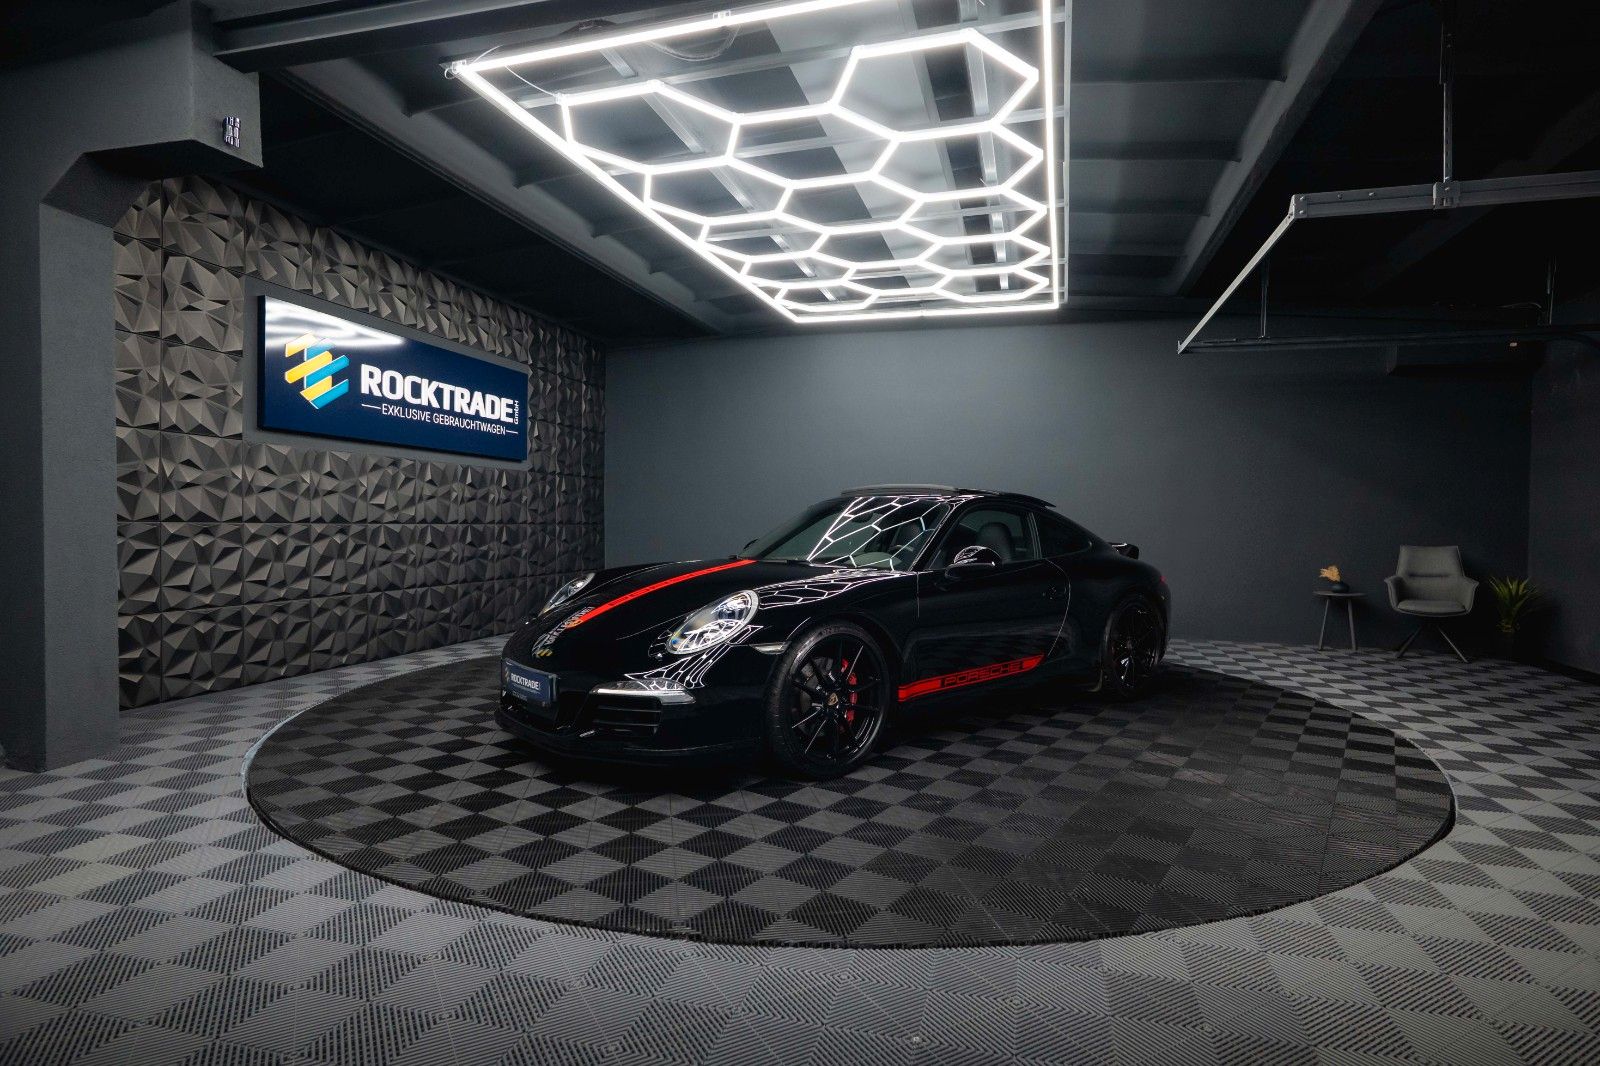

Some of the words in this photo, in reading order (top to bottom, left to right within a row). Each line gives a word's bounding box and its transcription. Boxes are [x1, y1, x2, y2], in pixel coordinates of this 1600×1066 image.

[361, 364, 513, 423] ROCKTRADE
[382, 403, 431, 423] EXKLUSIVE
[433, 412, 506, 435] GEBRAUCHTWAGEN
[511, 673, 539, 690] ROCKTRADE
[944, 661, 1021, 686] PORSCHE
